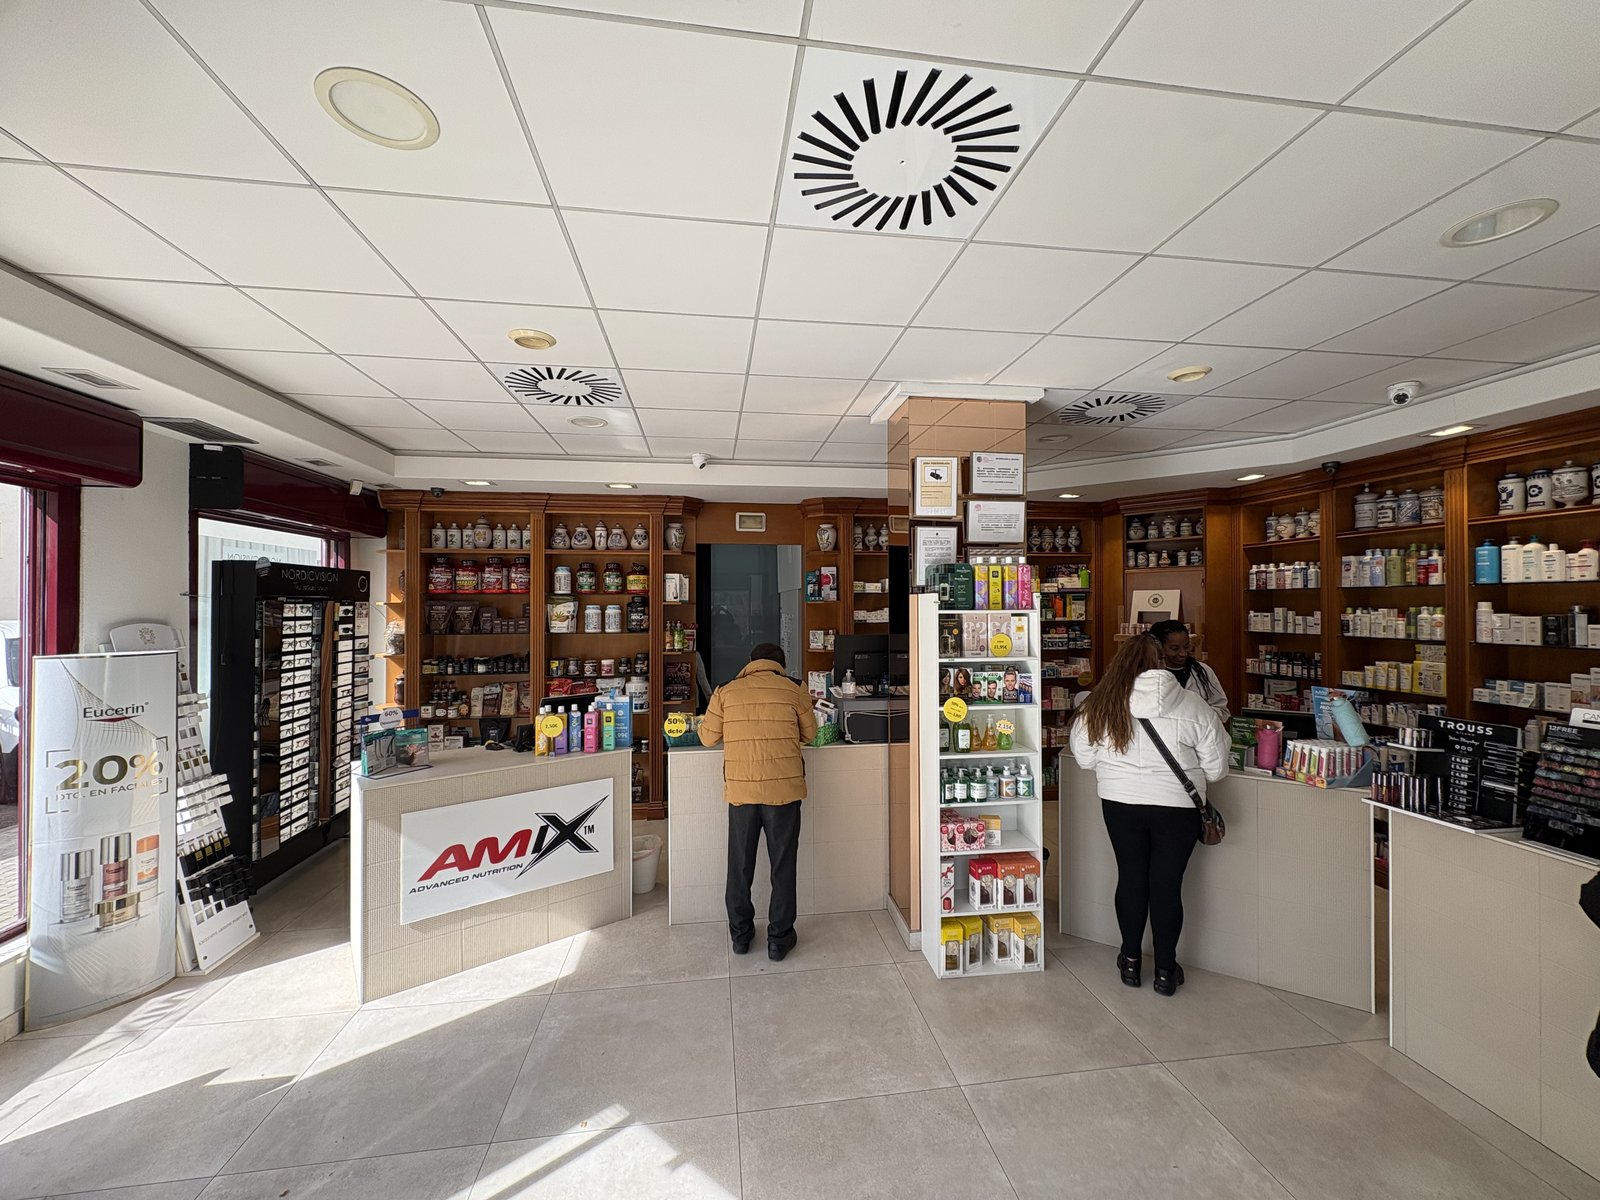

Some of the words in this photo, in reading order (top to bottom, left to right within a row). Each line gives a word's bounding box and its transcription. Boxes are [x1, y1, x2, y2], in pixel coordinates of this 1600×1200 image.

[281, 568, 339, 582] NORDICVISION
[83, 703, 145, 718] Eucerin
[1438, 720, 1494, 736] TROUSS
[55, 751, 164, 790] 20%
[90, 788, 107, 797] EN
[408, 875, 470, 894] ADVANCED
[472, 862, 524, 880] NUTRITION
